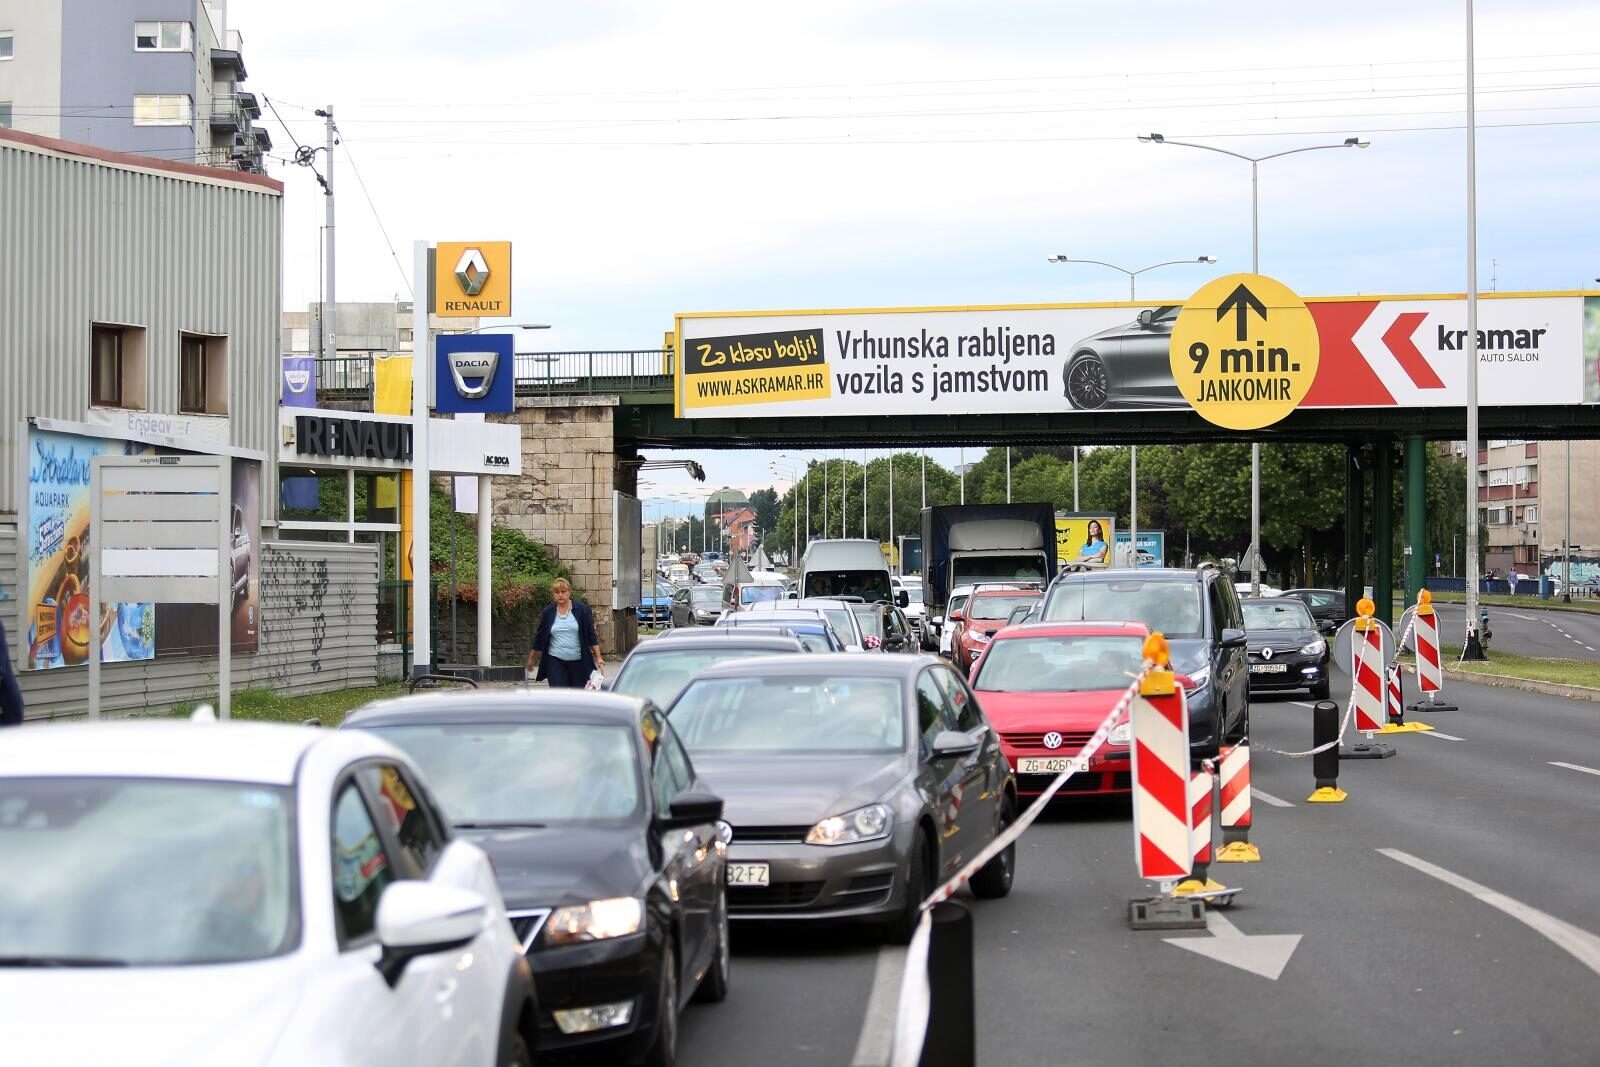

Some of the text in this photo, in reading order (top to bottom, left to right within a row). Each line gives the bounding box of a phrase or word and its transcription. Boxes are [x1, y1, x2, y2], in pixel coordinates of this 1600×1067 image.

[445, 301, 502, 311] RENAULT
[836, 327, 1055, 364] Vrhunska rabljena
[1438, 325, 1547, 351] kramar
[696, 335, 818, 367] Za klasu bolji!
[1188, 341, 1301, 373] 9 min.
[1480, 353, 1539, 363] AUTO SALON
[455, 360, 490, 368] DACIA
[697, 373, 824, 398] WWW.ASKRAMAR.HR
[836, 364, 1048, 401] vozila s jamstvom
[1196, 378, 1291, 402] JANKOMIR
[296, 416, 413, 461] RENAUL
[35, 491, 70, 508] AQUAPARK
[1025, 760, 1039, 771] ZG
